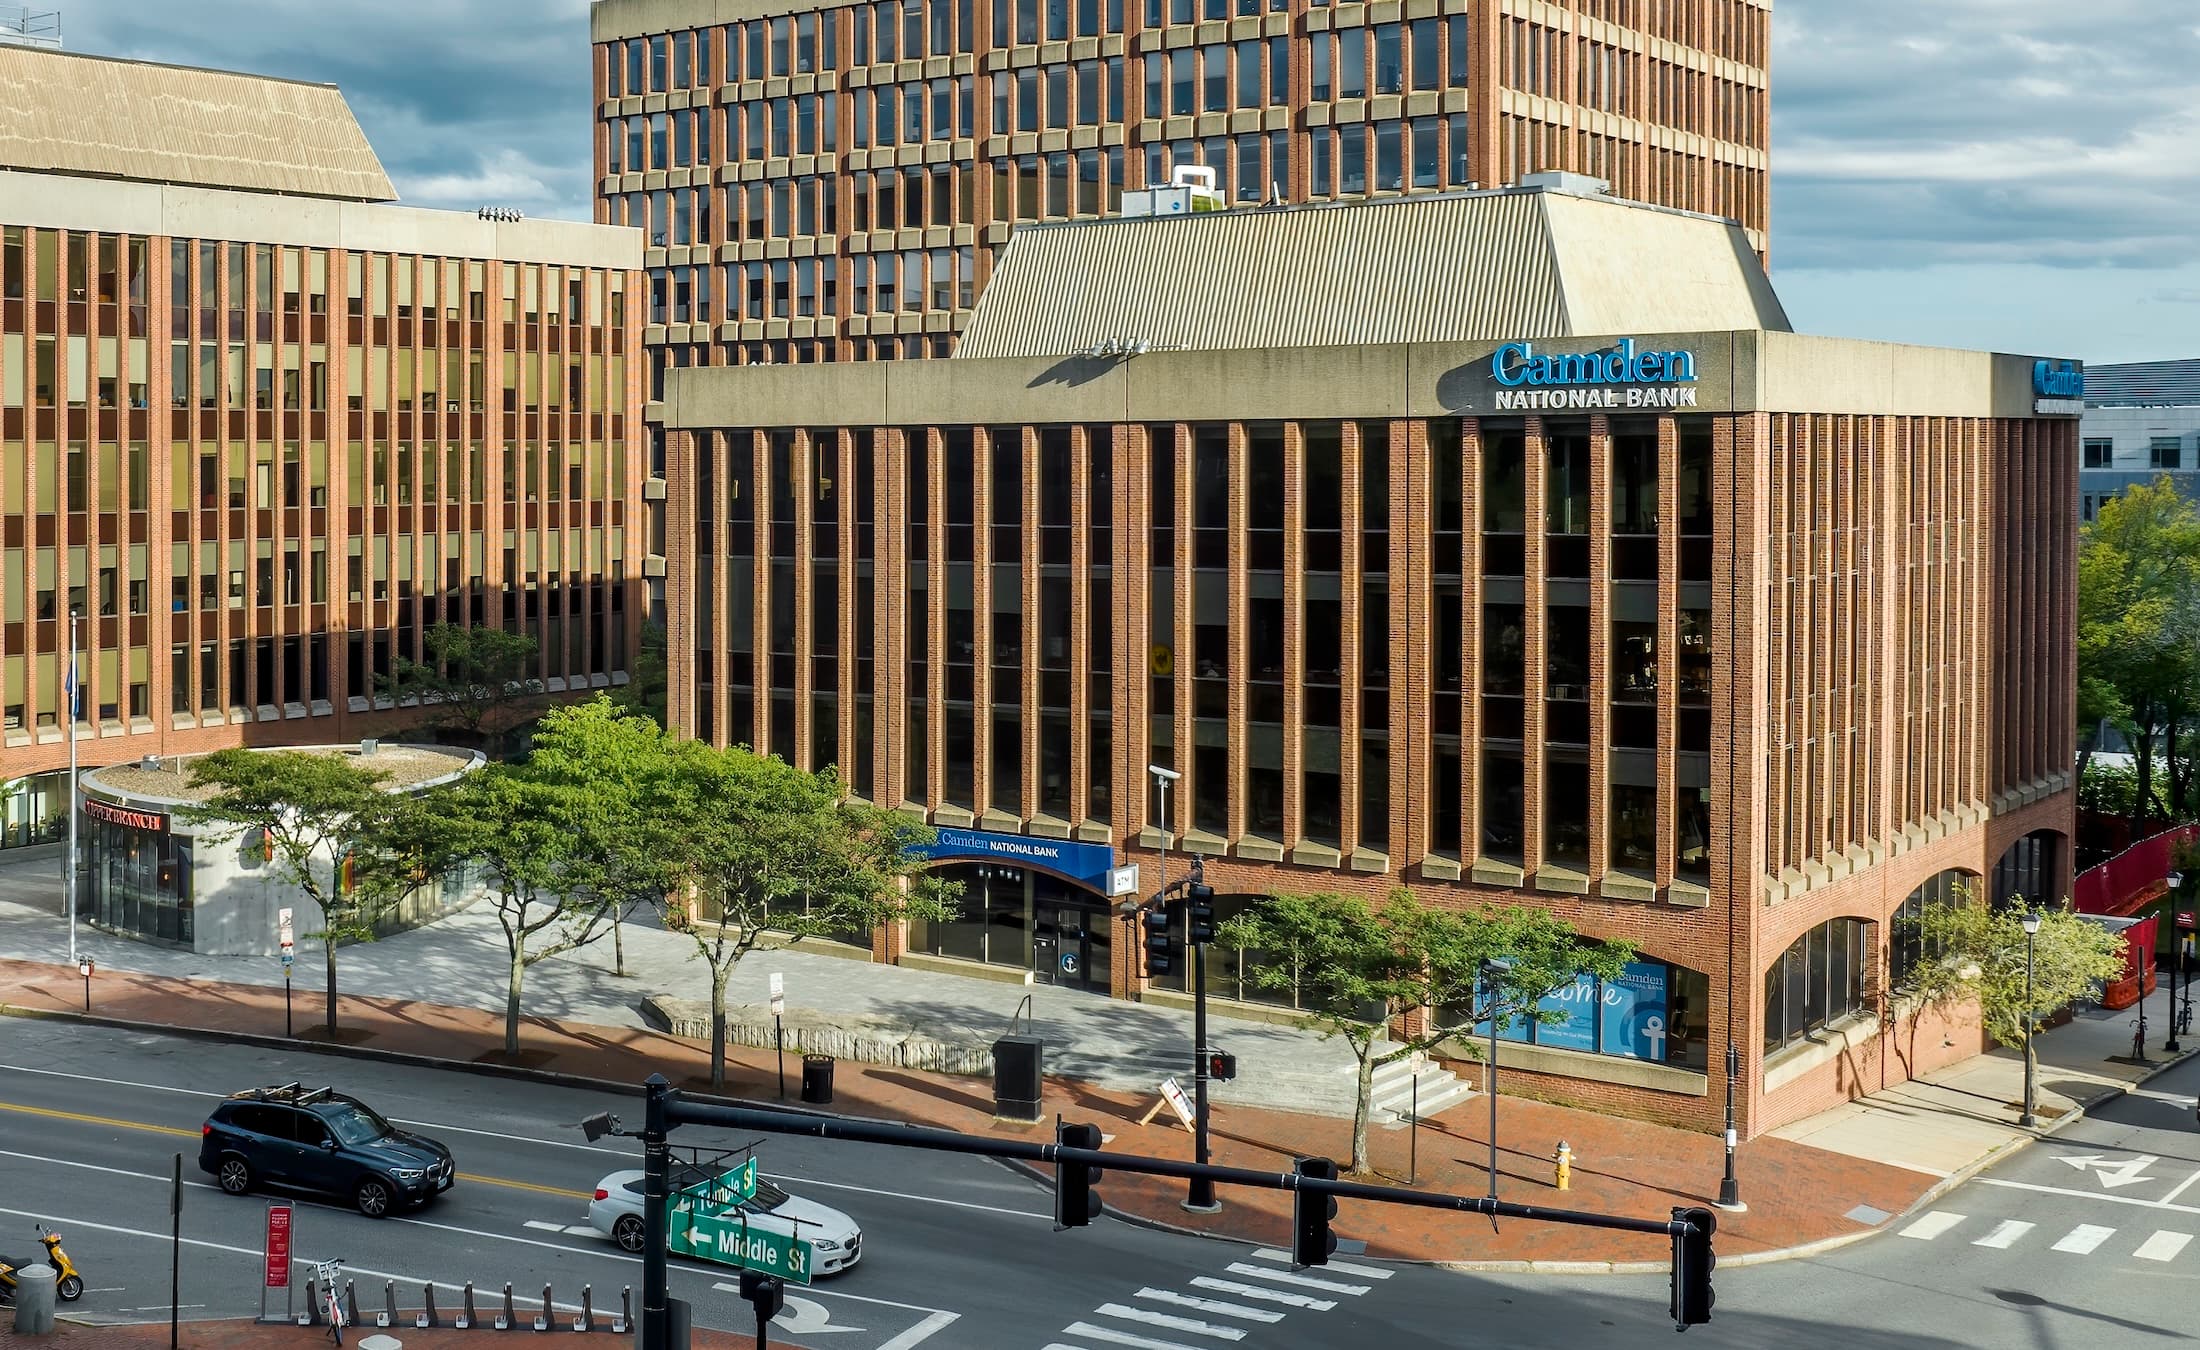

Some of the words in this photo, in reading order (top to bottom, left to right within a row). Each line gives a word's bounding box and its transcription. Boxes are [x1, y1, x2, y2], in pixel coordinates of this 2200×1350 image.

[1492, 337, 1698, 386] Camden
[2034, 360, 2083, 395] Camde
[1495, 388, 1617, 410] NATIONAL
[1627, 387, 1698, 408] BANK
[113, 809, 161, 830] BRANCH
[942, 832, 988, 850] Camden
[990, 841, 1033, 855] NATIONAL
[1034, 846, 1059, 858] BANK
[743, 1168, 753, 1190] St
[719, 1230, 777, 1265] Middle
[788, 1248, 805, 1273] St
